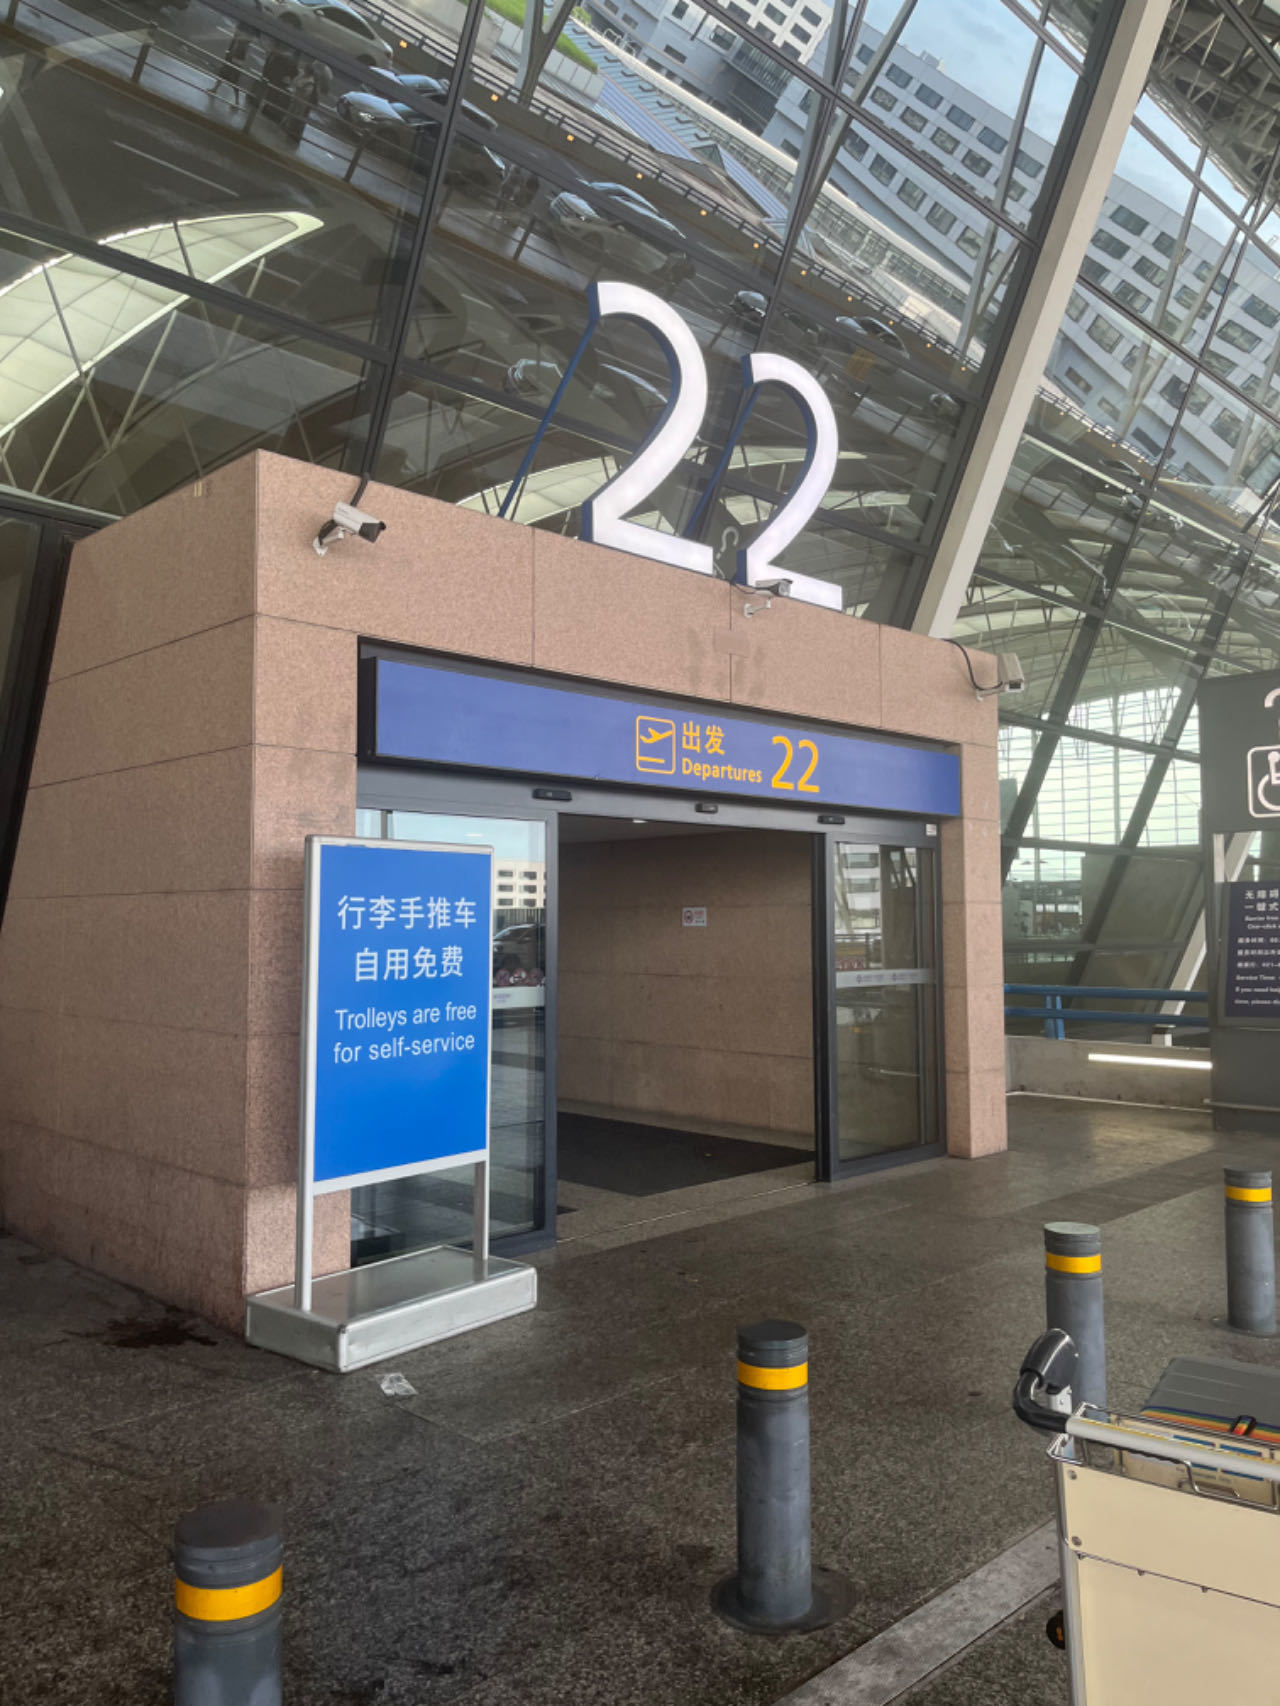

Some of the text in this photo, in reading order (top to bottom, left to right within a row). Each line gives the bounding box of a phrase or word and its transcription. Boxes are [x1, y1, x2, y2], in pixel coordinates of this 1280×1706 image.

[588, 280, 843, 612] 22
[682, 720, 725, 756] 出发
[682, 757, 763, 784] Departures
[771, 735, 820, 793] 22
[337, 895, 477, 930] 行李手推车
[355, 945, 464, 983] 自用免费
[334, 1001, 477, 1032] Trolleys are free
[333, 1031, 476, 1064] for self-service
